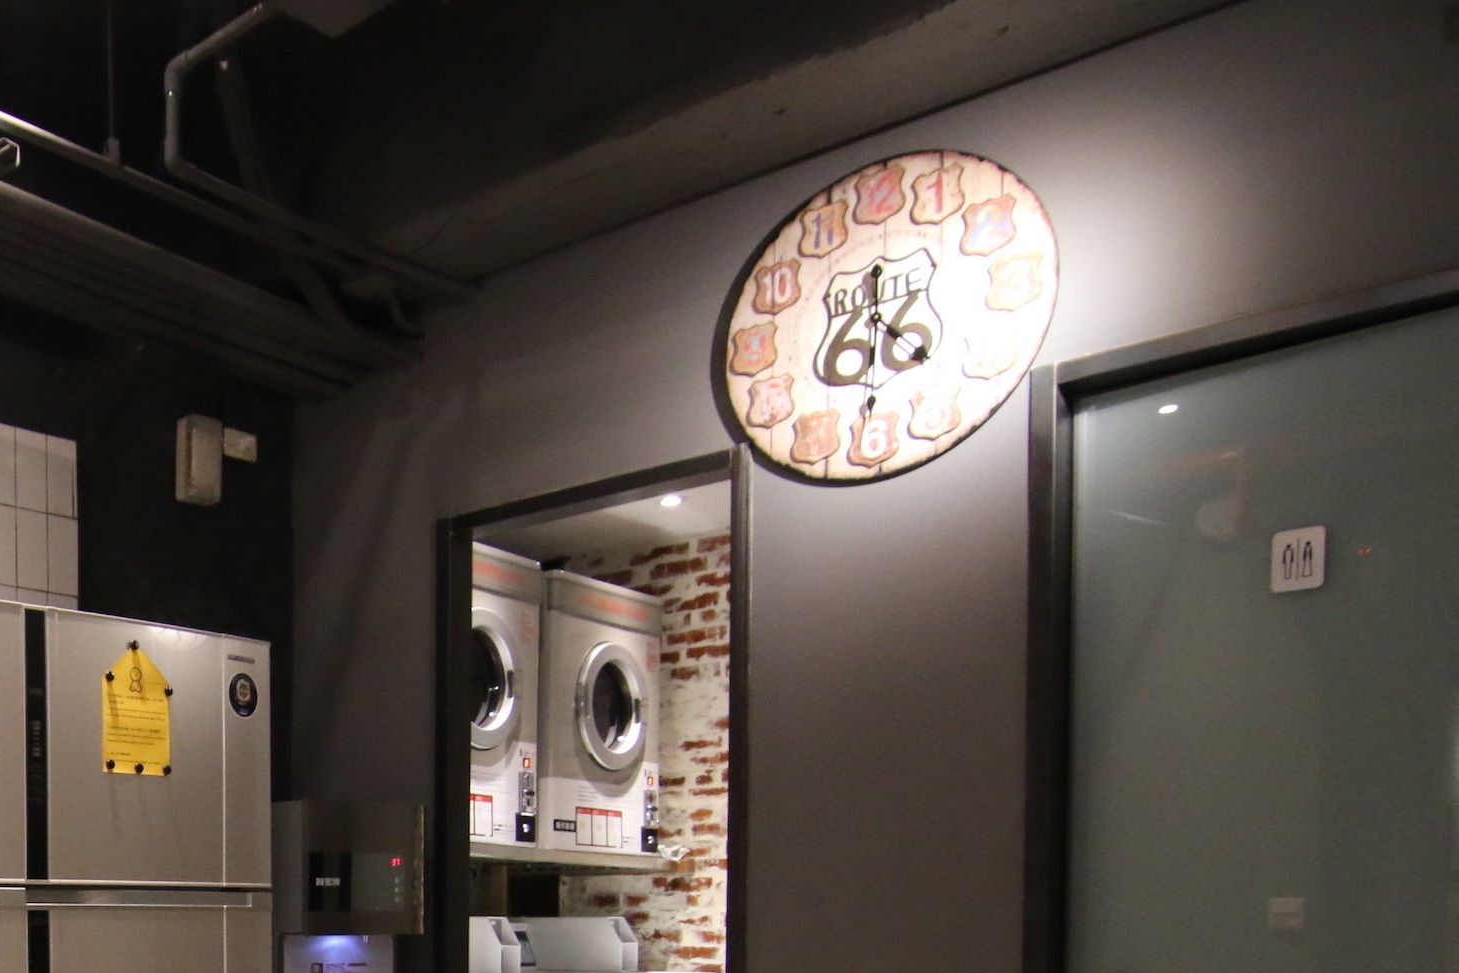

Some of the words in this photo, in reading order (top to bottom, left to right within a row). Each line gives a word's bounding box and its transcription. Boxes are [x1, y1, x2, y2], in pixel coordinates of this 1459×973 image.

[927, 171, 943, 213] 1
[811, 211, 835, 250] 11
[762, 266, 793, 306] 10
[823, 289, 933, 386] 66
[860, 418, 889, 459] 6
